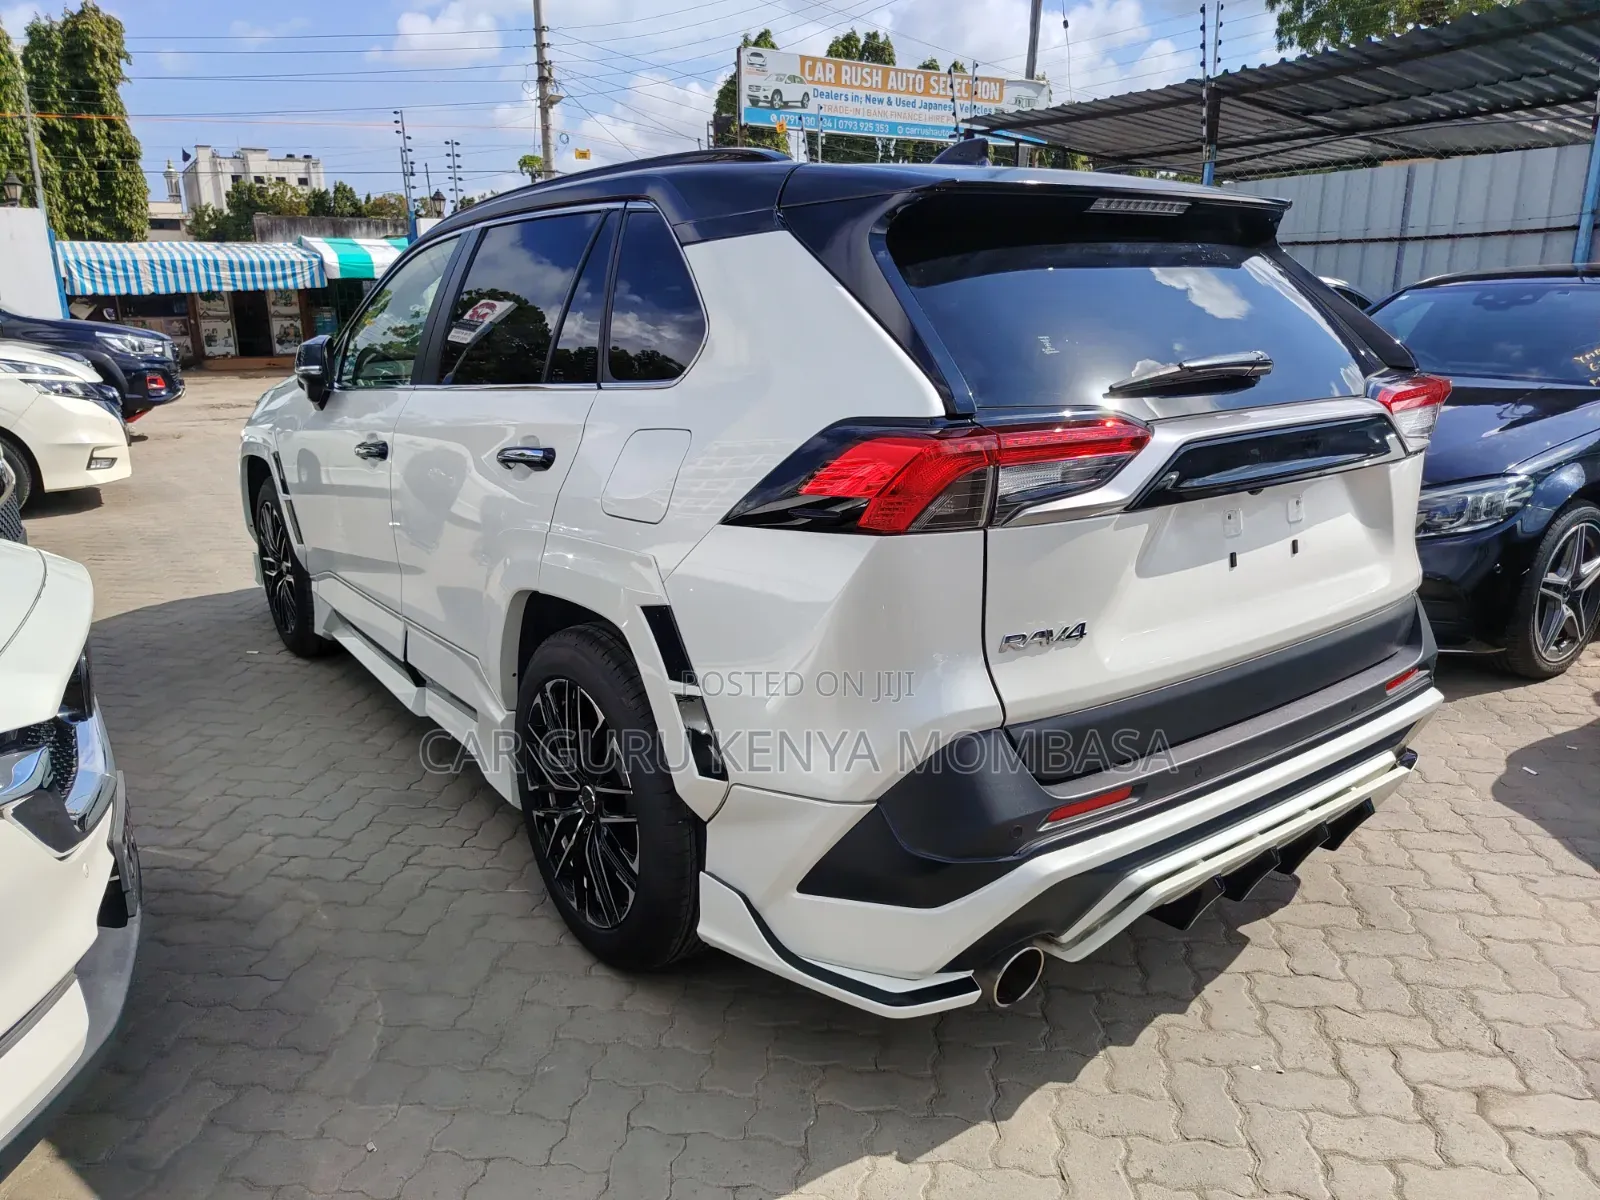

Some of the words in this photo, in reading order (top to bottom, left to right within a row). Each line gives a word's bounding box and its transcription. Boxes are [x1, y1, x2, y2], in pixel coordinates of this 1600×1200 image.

[804, 60, 836, 83] CAR
[841, 65, 882, 89] RUSH
[887, 70, 924, 94] AUTO
[813, 88, 849, 102] Dealers
[851, 93, 863, 105] in;
[865, 94, 884, 106] New
[886, 96, 893, 106] &
[895, 97, 917, 108] Used
[918, 99, 954, 112] Japanes
[801, 116, 815, 126] 30
[819, 118, 832, 128] 34
[838, 119, 858, 131] 0793
[860, 121, 874, 132] 925
[875, 123, 889, 133] 353
[822, 103, 860, 116] TRADE-IN
[866, 109, 888, 119] BANK
[890, 110, 923, 122] FINANCE
[928, 114, 945, 124] HIRE
[998, 620, 1088, 653] RAV4
